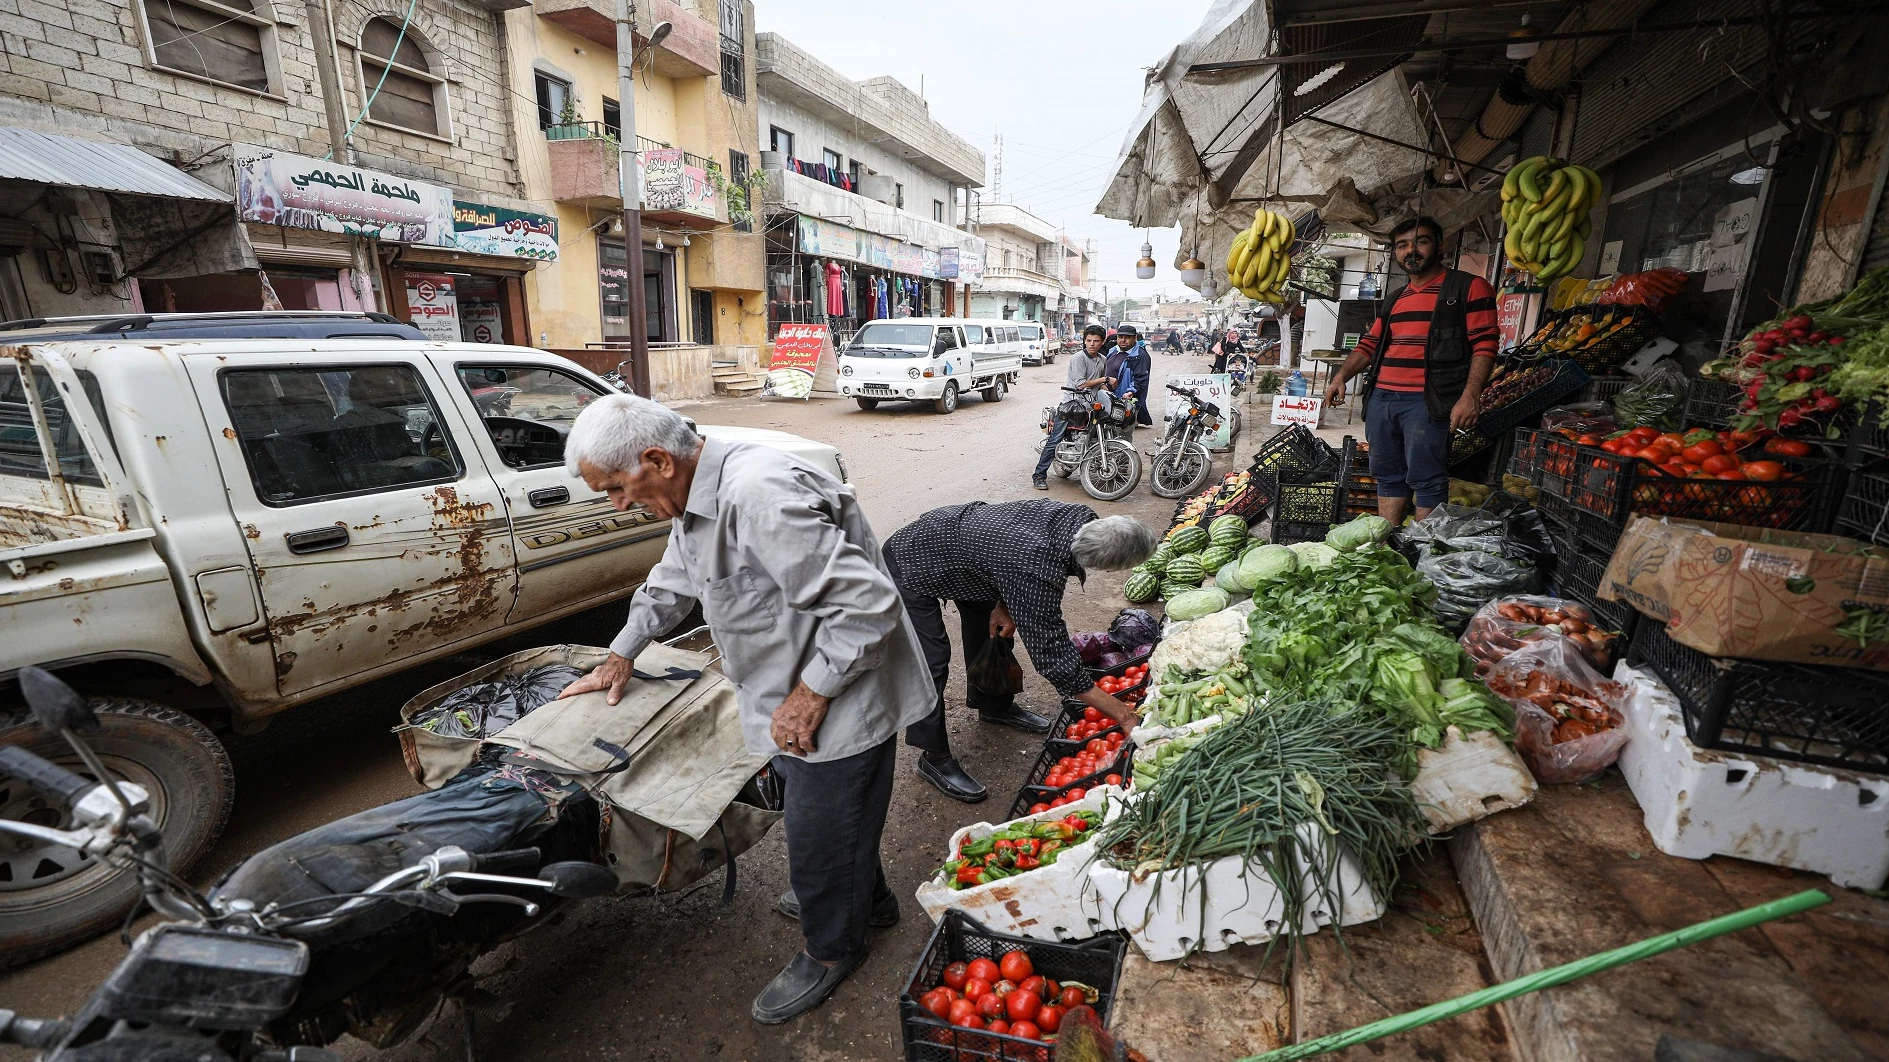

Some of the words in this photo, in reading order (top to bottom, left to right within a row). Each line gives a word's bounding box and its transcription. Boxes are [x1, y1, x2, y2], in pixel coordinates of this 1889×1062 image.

[646, 157, 666, 174] بلال
[290, 169, 366, 192] الحمصي
[283, 189, 300, 199] سوري
[370, 178, 421, 204] ملحمة
[461, 208, 497, 227] للصرافة
[1709, 259, 1737, 277] GOAL
[778, 327, 796, 339] الجبن
[795, 327, 812, 339] حلاوة
[1183, 379, 1213, 387] حلويات
[1209, 377, 1227, 399] أبو
